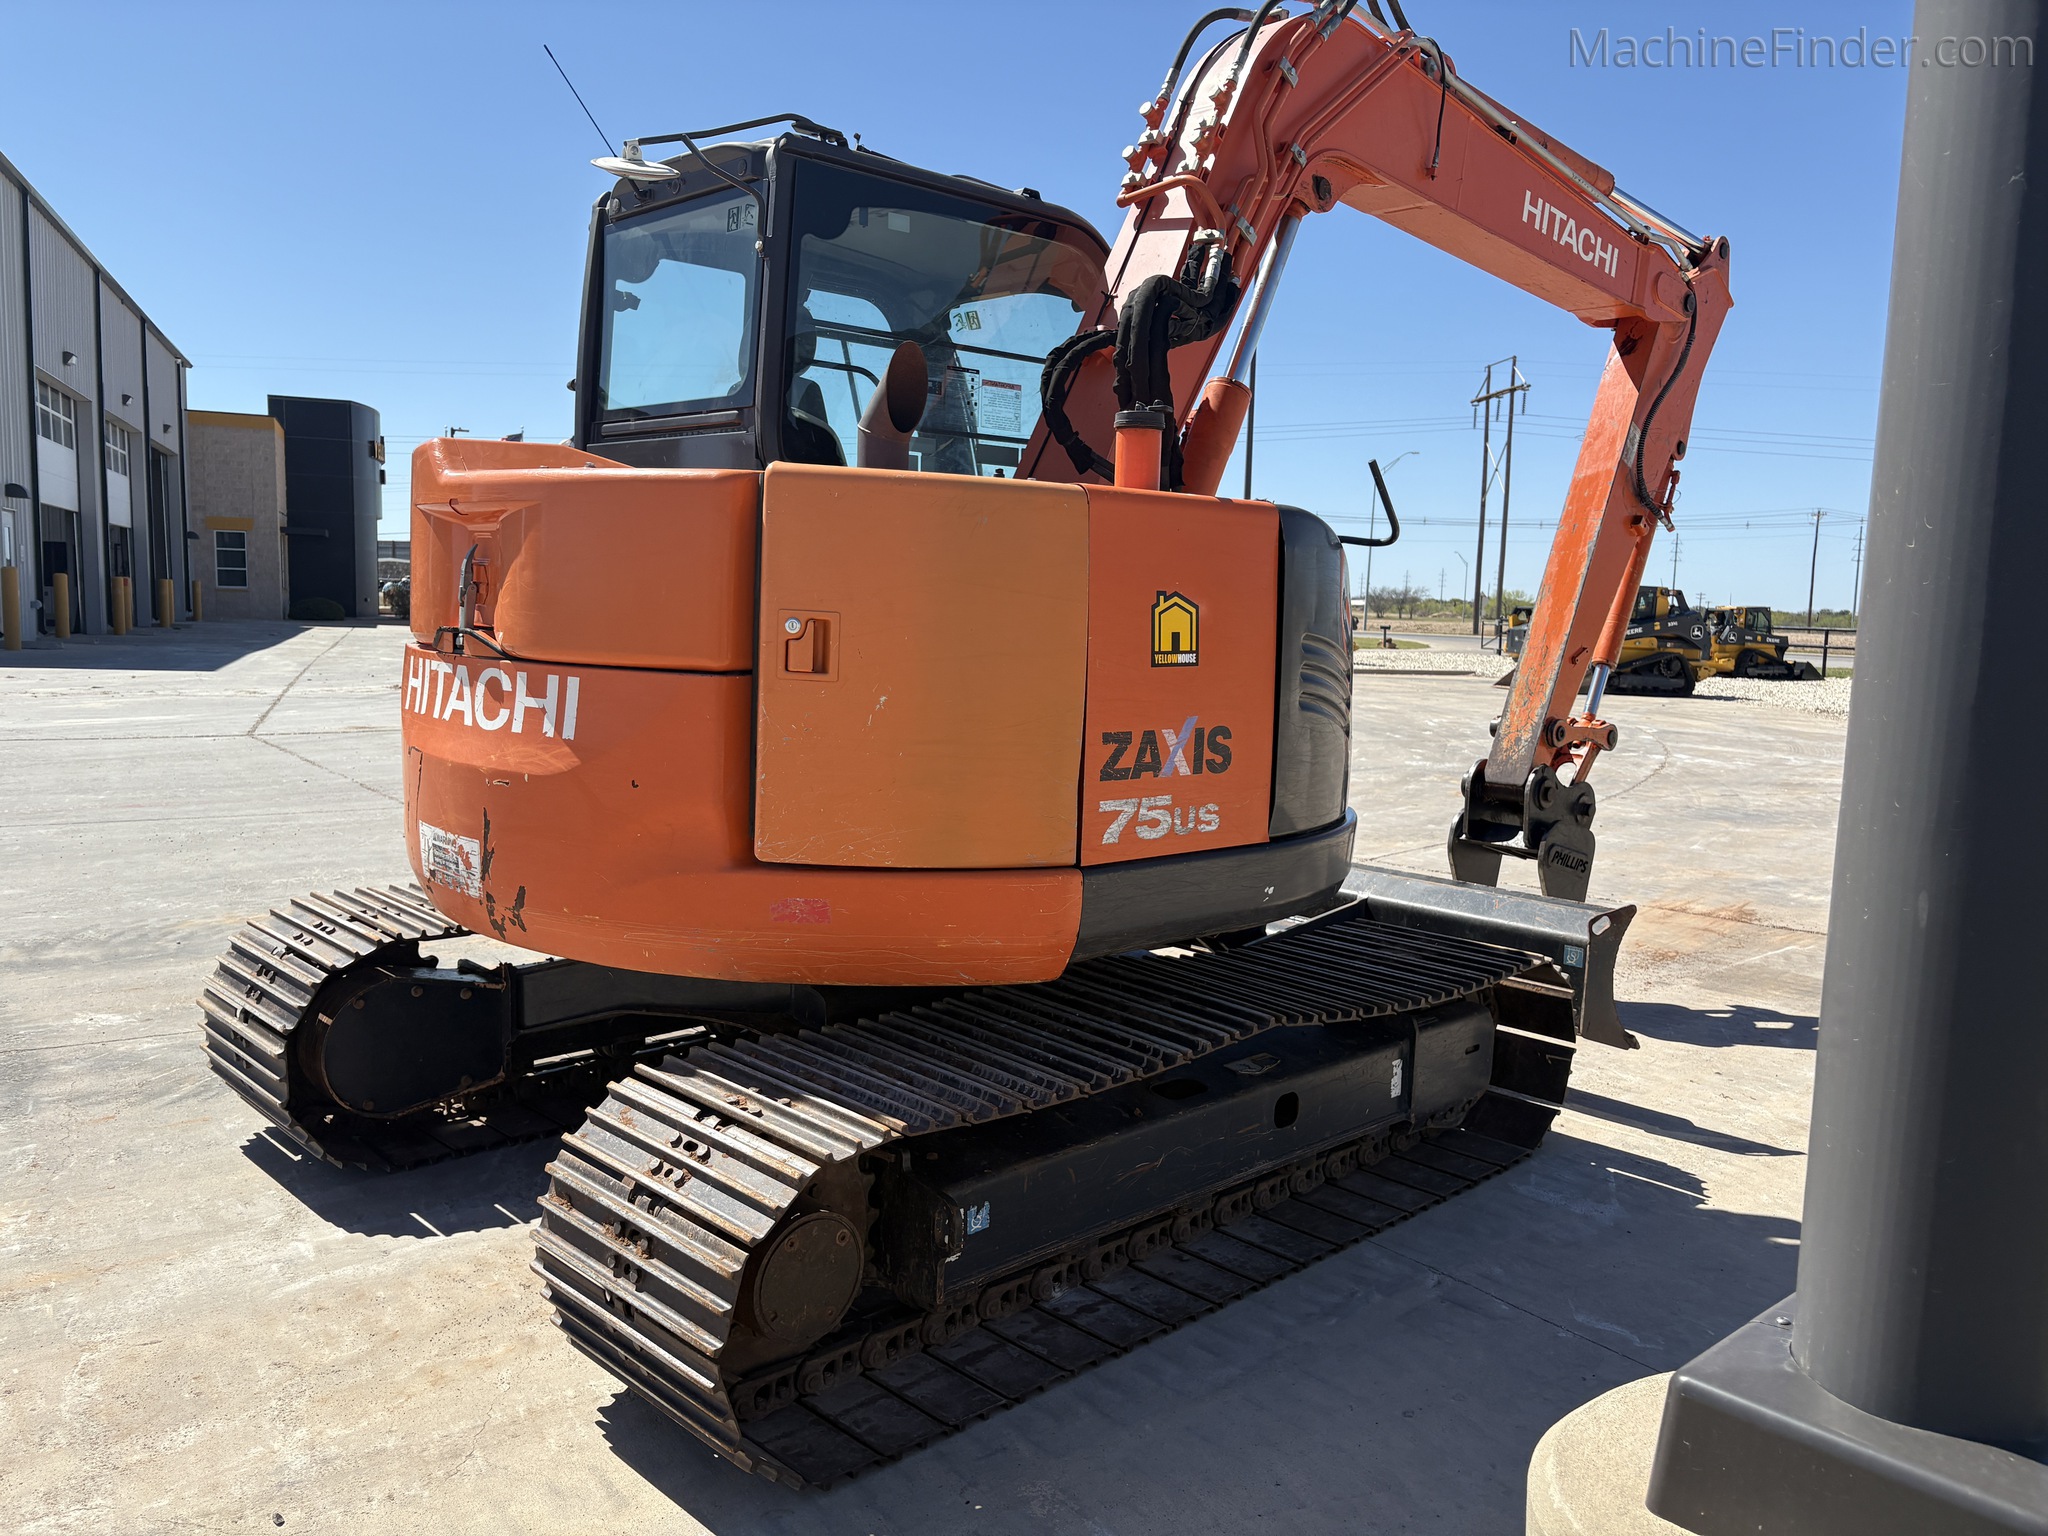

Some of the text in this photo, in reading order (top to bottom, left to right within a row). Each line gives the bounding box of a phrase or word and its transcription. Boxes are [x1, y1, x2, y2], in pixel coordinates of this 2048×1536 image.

[1522, 189, 1619, 278] HITACHI
[1154, 653, 1197, 664] YELLOWHOUSE
[405, 655, 580, 740] HITACHI
[1099, 716, 1233, 781] ZAXIS
[1551, 850, 1589, 873] PHILLIPS
